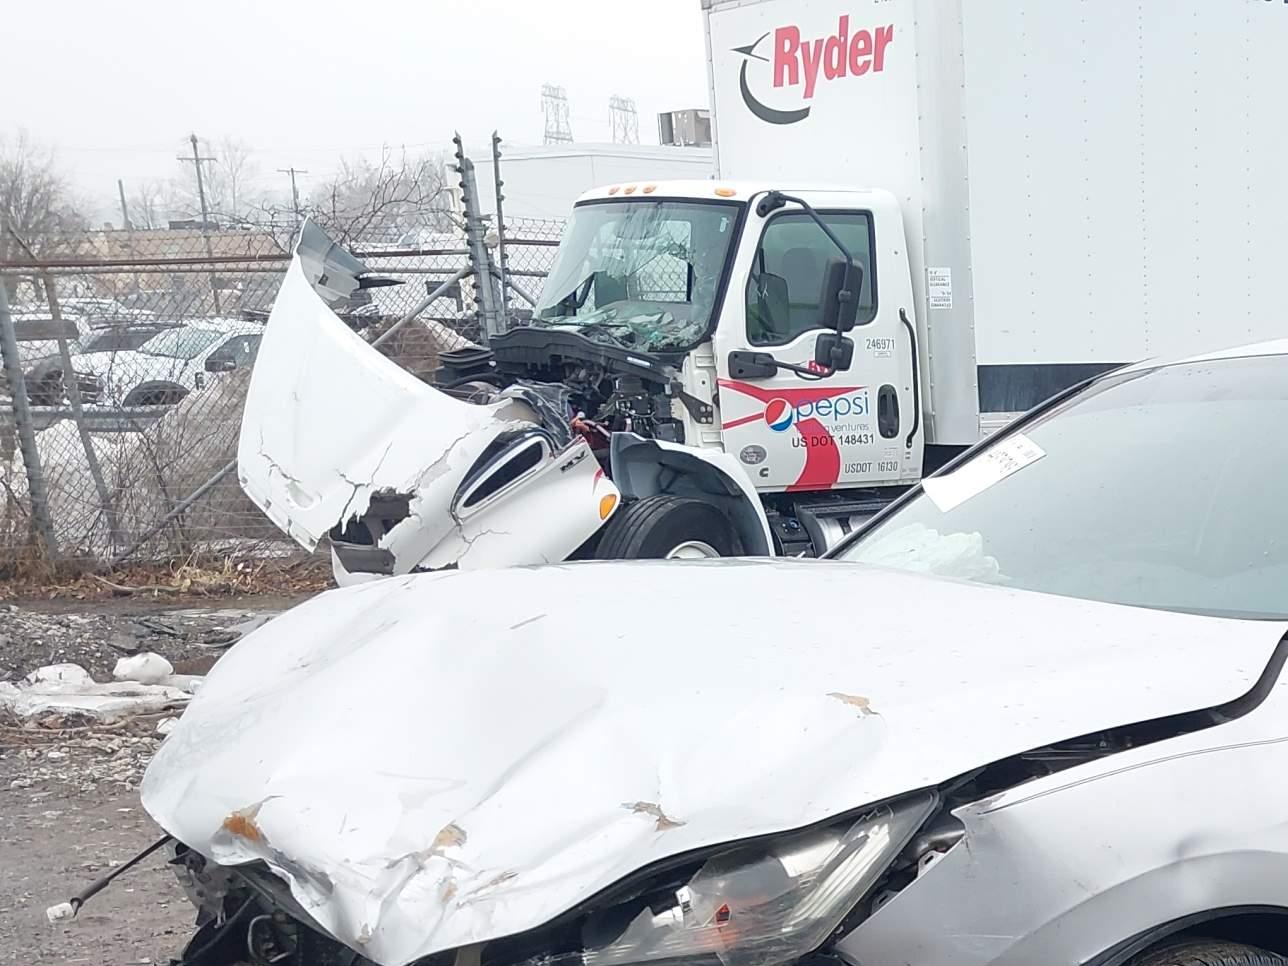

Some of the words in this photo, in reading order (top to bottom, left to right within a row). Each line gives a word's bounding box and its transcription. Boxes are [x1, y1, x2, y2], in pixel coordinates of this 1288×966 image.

[773, 15, 894, 99] Ryder
[865, 338, 895, 350] 246971
[796, 391, 869, 423] pepsi
[792, 436, 808, 448] US
[811, 435, 835, 447] DOT
[839, 433, 874, 446] 148431
[844, 462, 873, 474] USDOT
